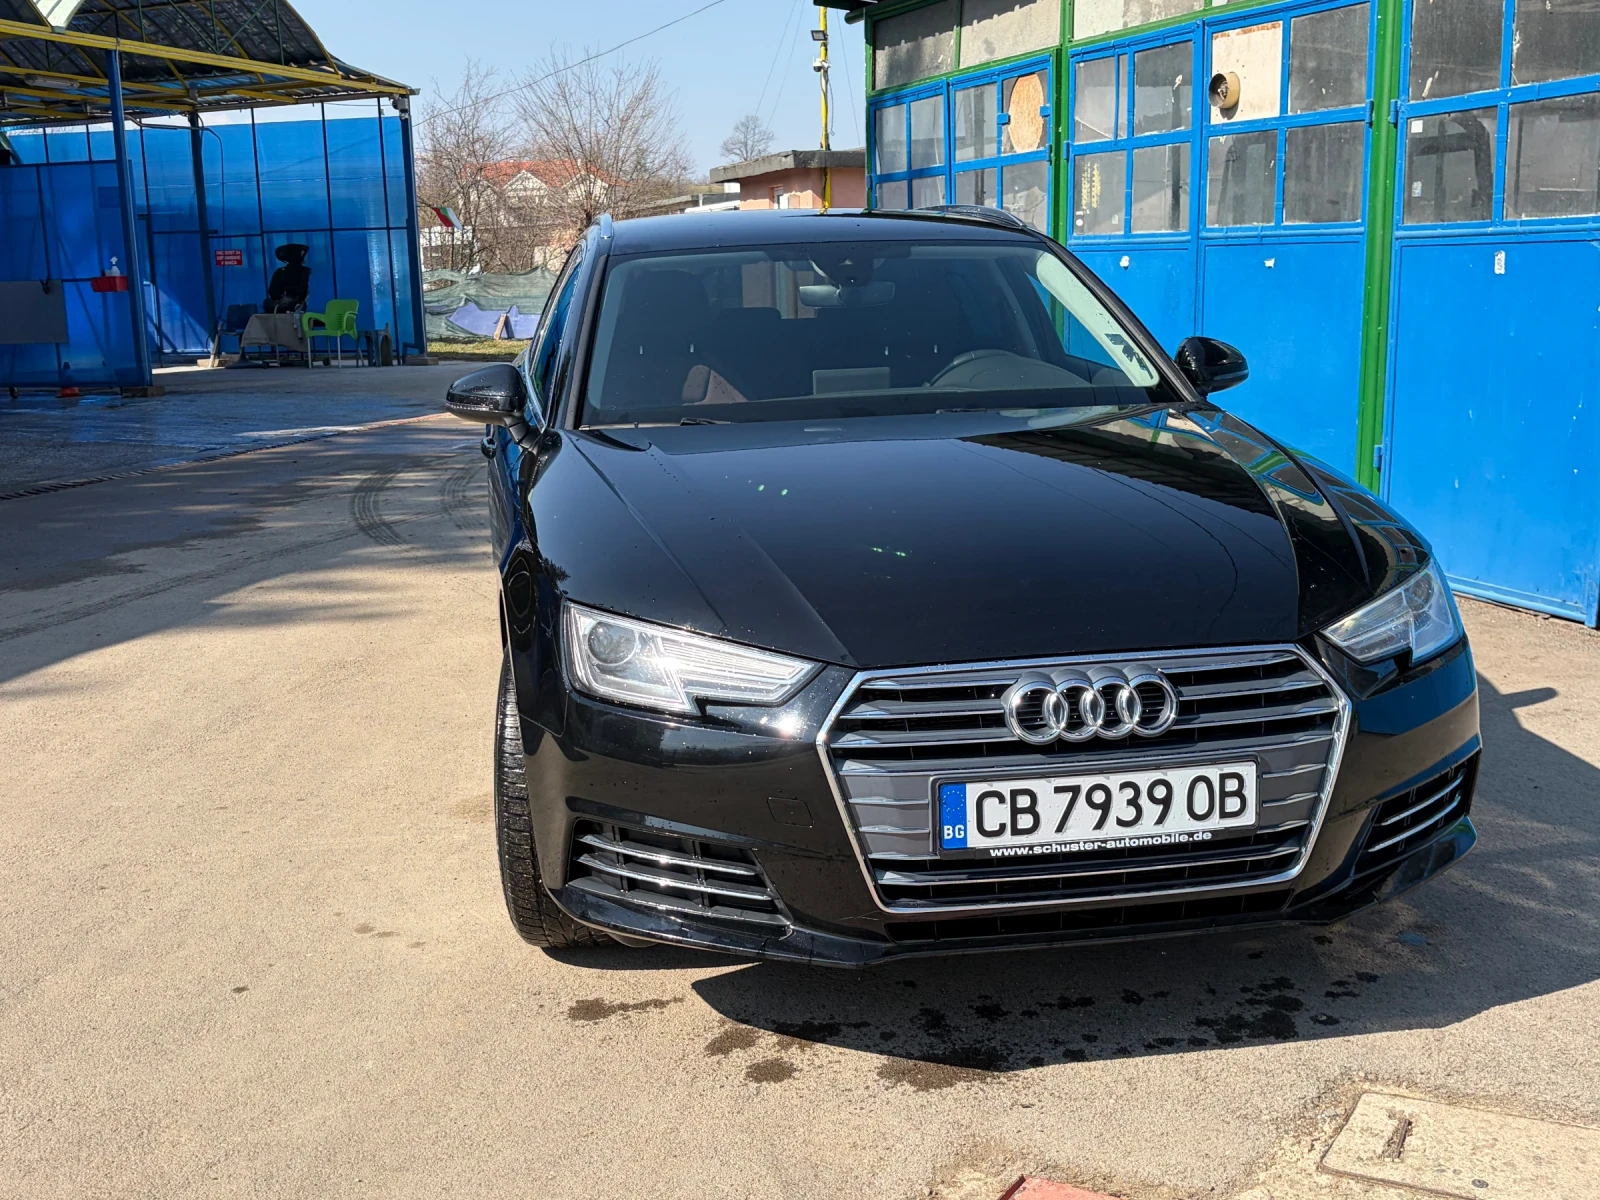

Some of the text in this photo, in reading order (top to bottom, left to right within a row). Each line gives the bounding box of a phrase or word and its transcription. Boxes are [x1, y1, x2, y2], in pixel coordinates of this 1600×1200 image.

[975, 771, 1247, 838] CB 7939 OB
[943, 824, 965, 840] BG
[989, 831, 1213, 857] www.schuster-automobile.de
